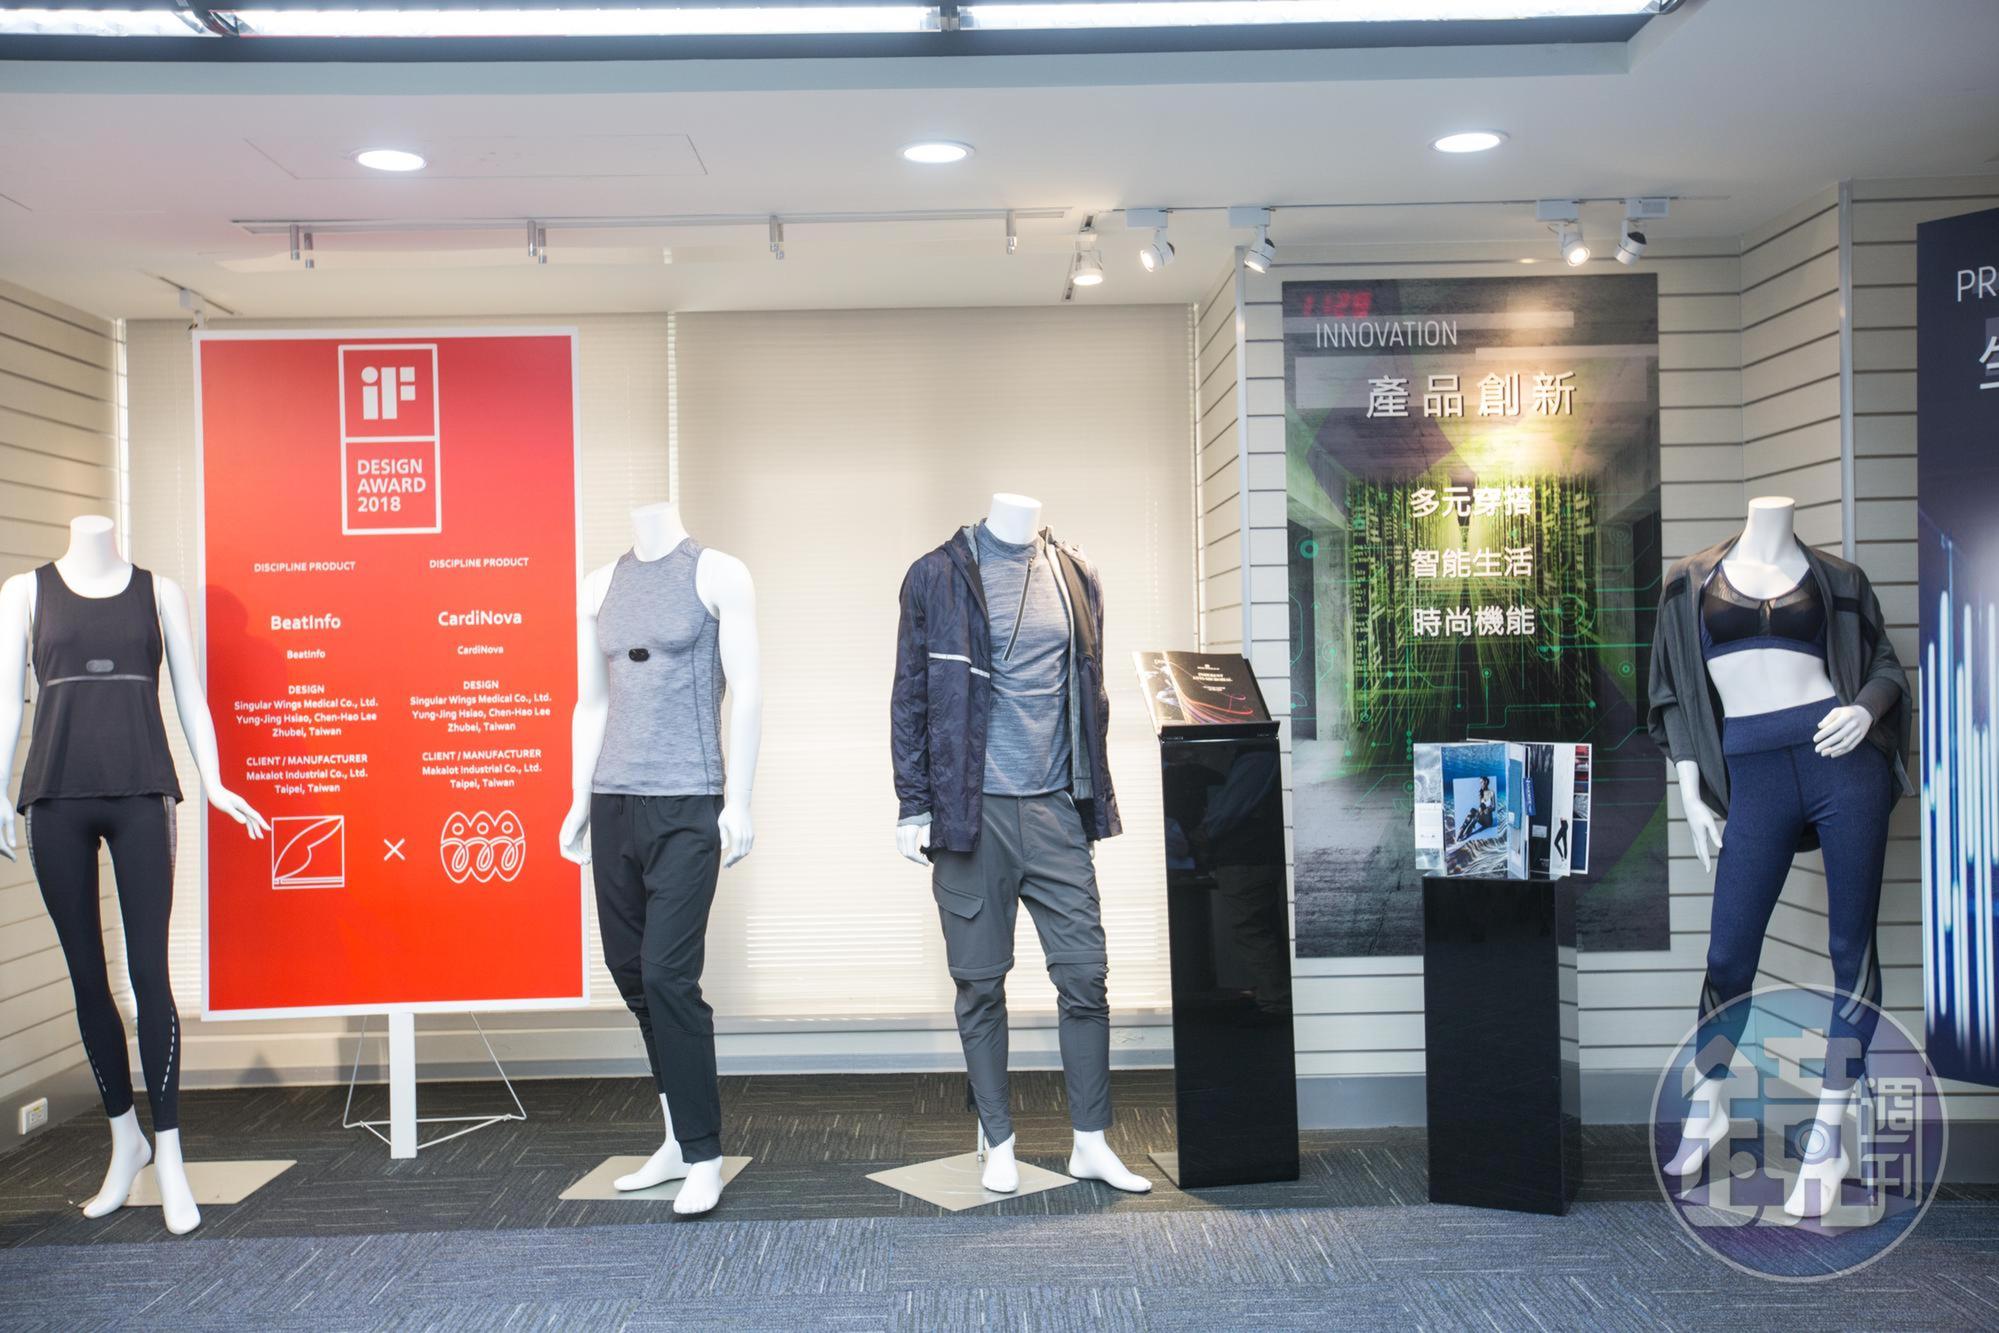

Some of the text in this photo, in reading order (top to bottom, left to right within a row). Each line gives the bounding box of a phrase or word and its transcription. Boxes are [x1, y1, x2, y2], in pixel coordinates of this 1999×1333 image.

[1316, 320, 1457, 348] INNOVATION
[1366, 370, 1576, 419] 產品創新
[357, 459, 423, 475] DESIGN
[357, 478, 426, 493] AWARD
[357, 497, 401, 512] 2018
[1410, 485, 1532, 518] 多元穿搭
[255, 561, 355, 573] DISCIPLINE PRODUCT
[430, 558, 528, 569] DISCIPLINE PRODUCT
[1411, 546, 1533, 578] 智能生活
[271, 614, 341, 630] BeatInfo
[438, 610, 522, 625] CardiNova
[1413, 605, 1535, 637] 時尚機能
[287, 649, 325, 659] BeatInfo
[458, 646, 503, 655] CardiNova
[289, 685, 324, 695] DESIGN
[464, 680, 499, 690] DESIGN
[235, 701, 272, 712] Singular
[274, 700, 302, 711] Wings
[304, 699, 338, 709] Medical
[360, 698, 378, 707] Ltd.
[410, 696, 447, 707] Singular
[449, 695, 476, 706] Wings
[478, 694, 512, 704] Medical
[534, 694, 551, 703] Ltd.
[359, 713, 377, 722] Lee
[533, 708, 550, 717] Lee
[309, 727, 341, 736] Taiwan
[484, 722, 516, 732] Taiwan
[247, 757, 280, 767] CLIENT
[288, 754, 367, 764] MANUFACTURER
[423, 752, 456, 761] CLIENT
[463, 749, 541, 759] MANUFACTURER
[247, 771, 283, 781] Makalot
[286, 770, 327, 780] Industrial
[350, 768, 367, 778] Ltd.
[423, 766, 459, 776] Makalot
[461, 764, 503, 774] Industrial
[524, 763, 541, 773] Ltd.
[308, 784, 340, 793] Taiwan
[483, 778, 514, 788] Taiwan
